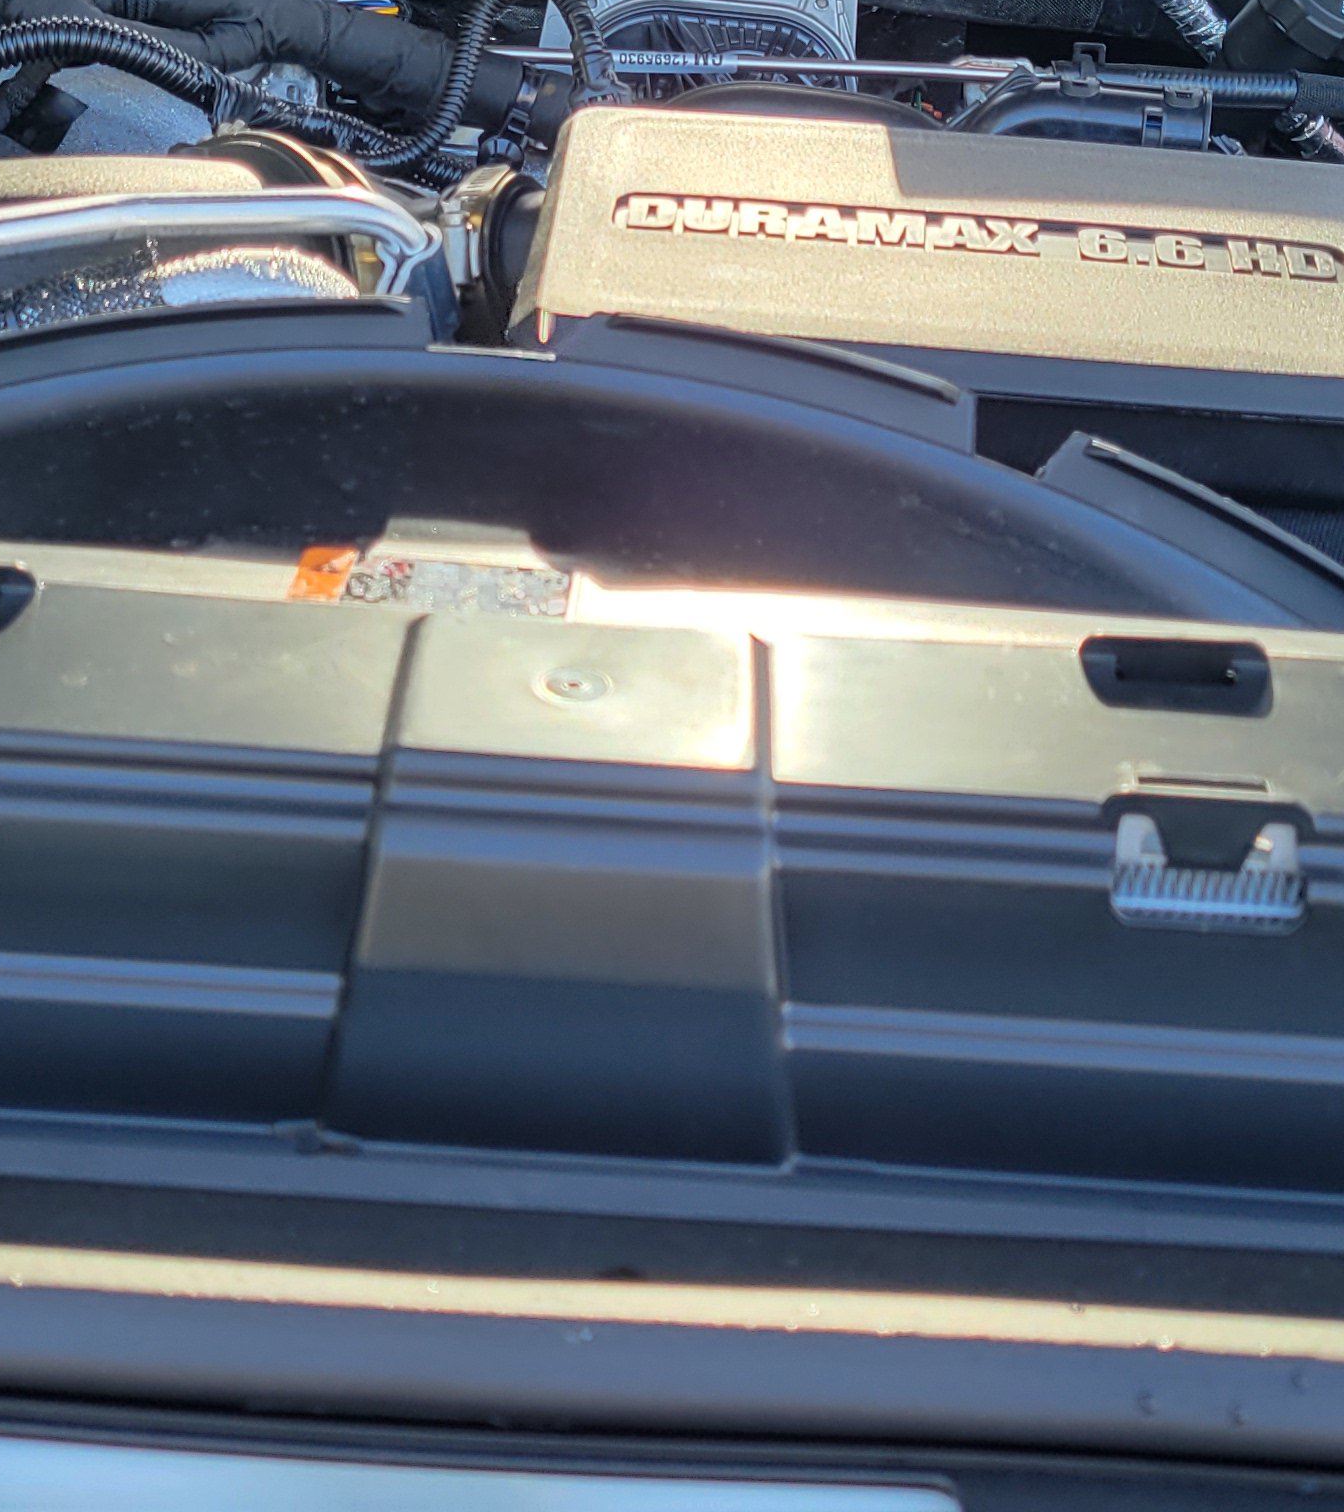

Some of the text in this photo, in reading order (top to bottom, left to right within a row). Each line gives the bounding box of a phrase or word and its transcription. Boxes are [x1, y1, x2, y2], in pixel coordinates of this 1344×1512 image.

[619, 52, 723, 66] GM 12695930
[625, 194, 1339, 282] DURAMAX 6.6 HD
